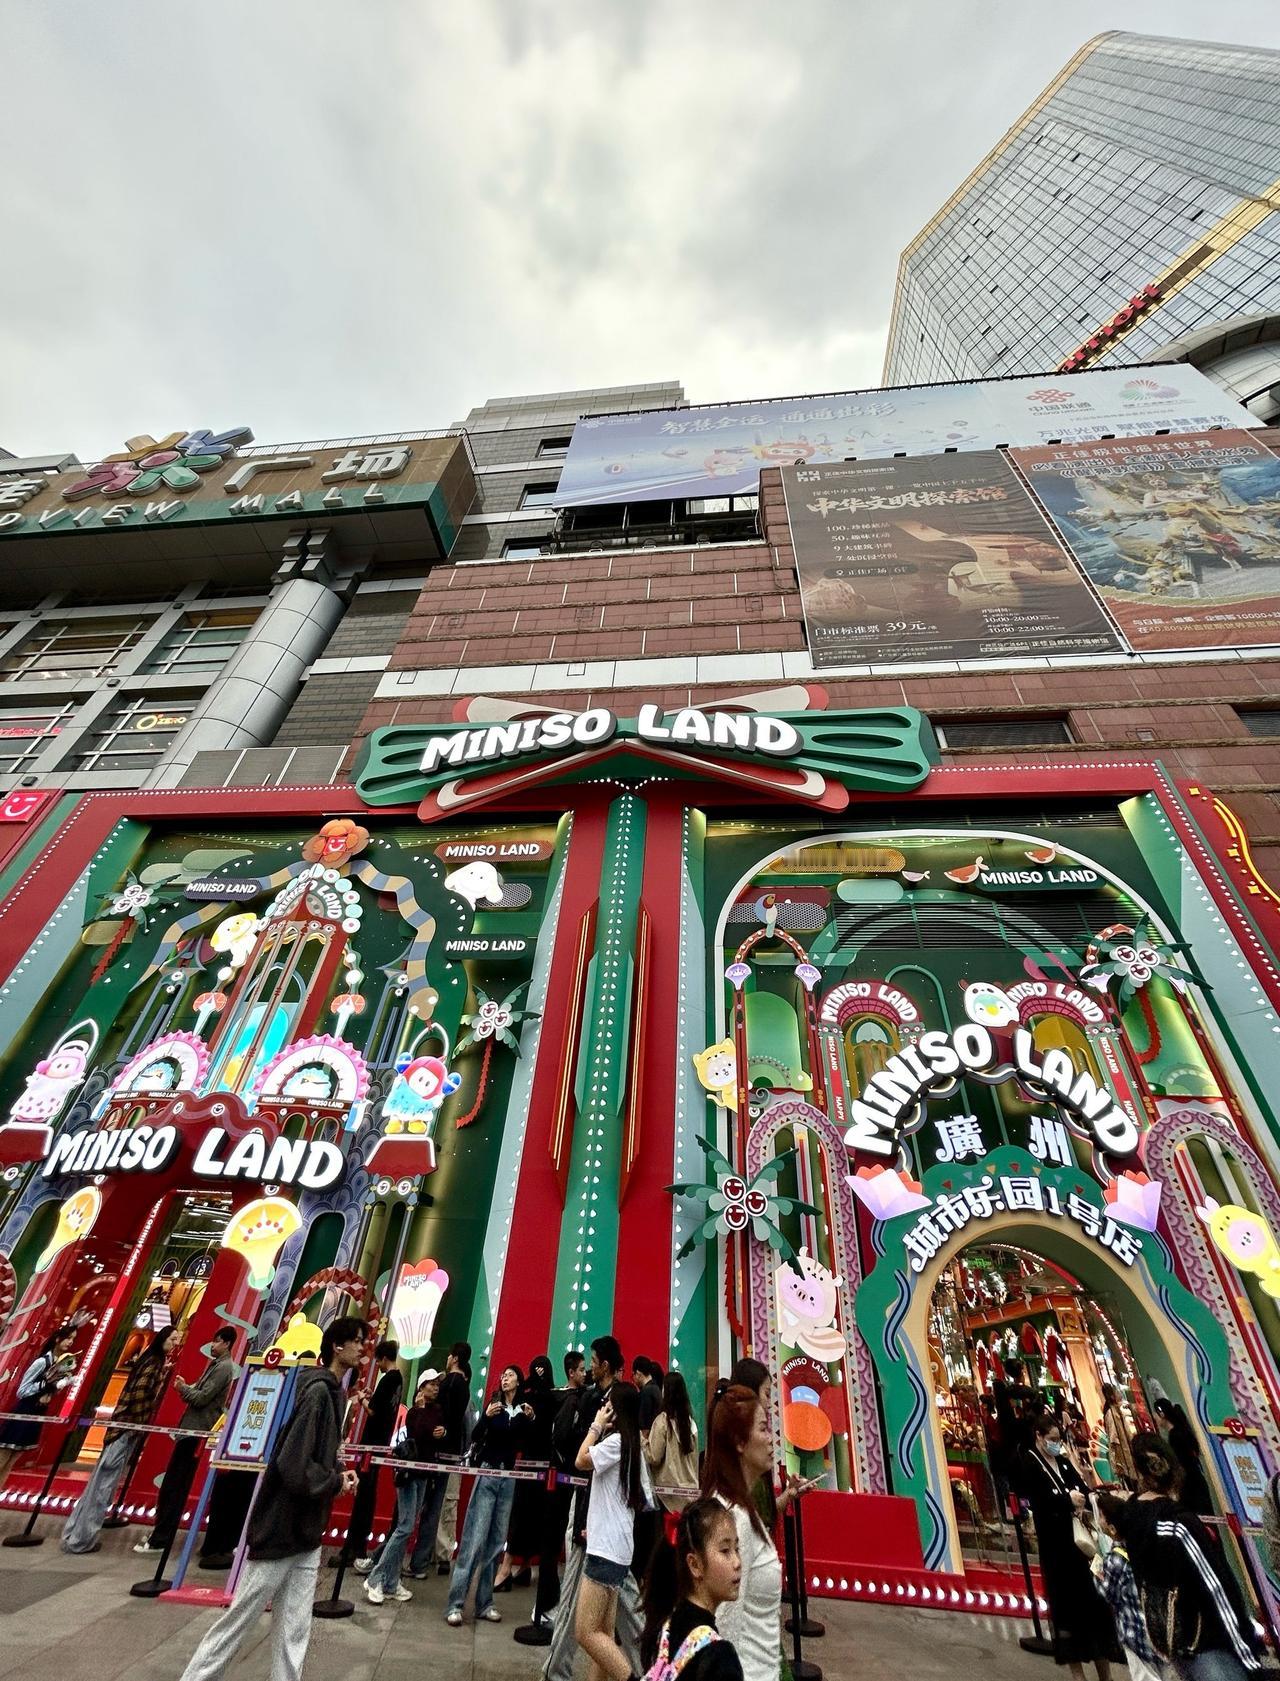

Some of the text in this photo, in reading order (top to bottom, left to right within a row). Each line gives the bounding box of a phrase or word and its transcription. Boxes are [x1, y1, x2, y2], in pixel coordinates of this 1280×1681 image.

[1052, 440, 1213, 460] 正佳极地海洋世界
[223, 445, 413, 495] 广场
[228, 483, 385, 516] MALL
[806, 486, 1008, 519] 中华文明探索馆
[419, 703, 803, 773] MINISO LAND
[446, 843, 540, 857] MINISO LAND
[186, 883, 257, 895] MINISO LAND
[981, 868, 1098, 885] MINISO LAND
[317, 884, 343, 920] LAND
[446, 940, 526, 951] MINISO LAND
[821, 982, 918, 1023] MINISO LAND
[1055, 983, 1104, 1022] LAND
[843, 1023, 1139, 1158] MINISO LAND
[42, 1125, 345, 1189] MINISO LAND
[902, 1175, 1143, 1273] 城市乐园1号店
[783, 1357, 830, 1383] MINISO LAND
[242, 1415, 266, 1430] 入口
